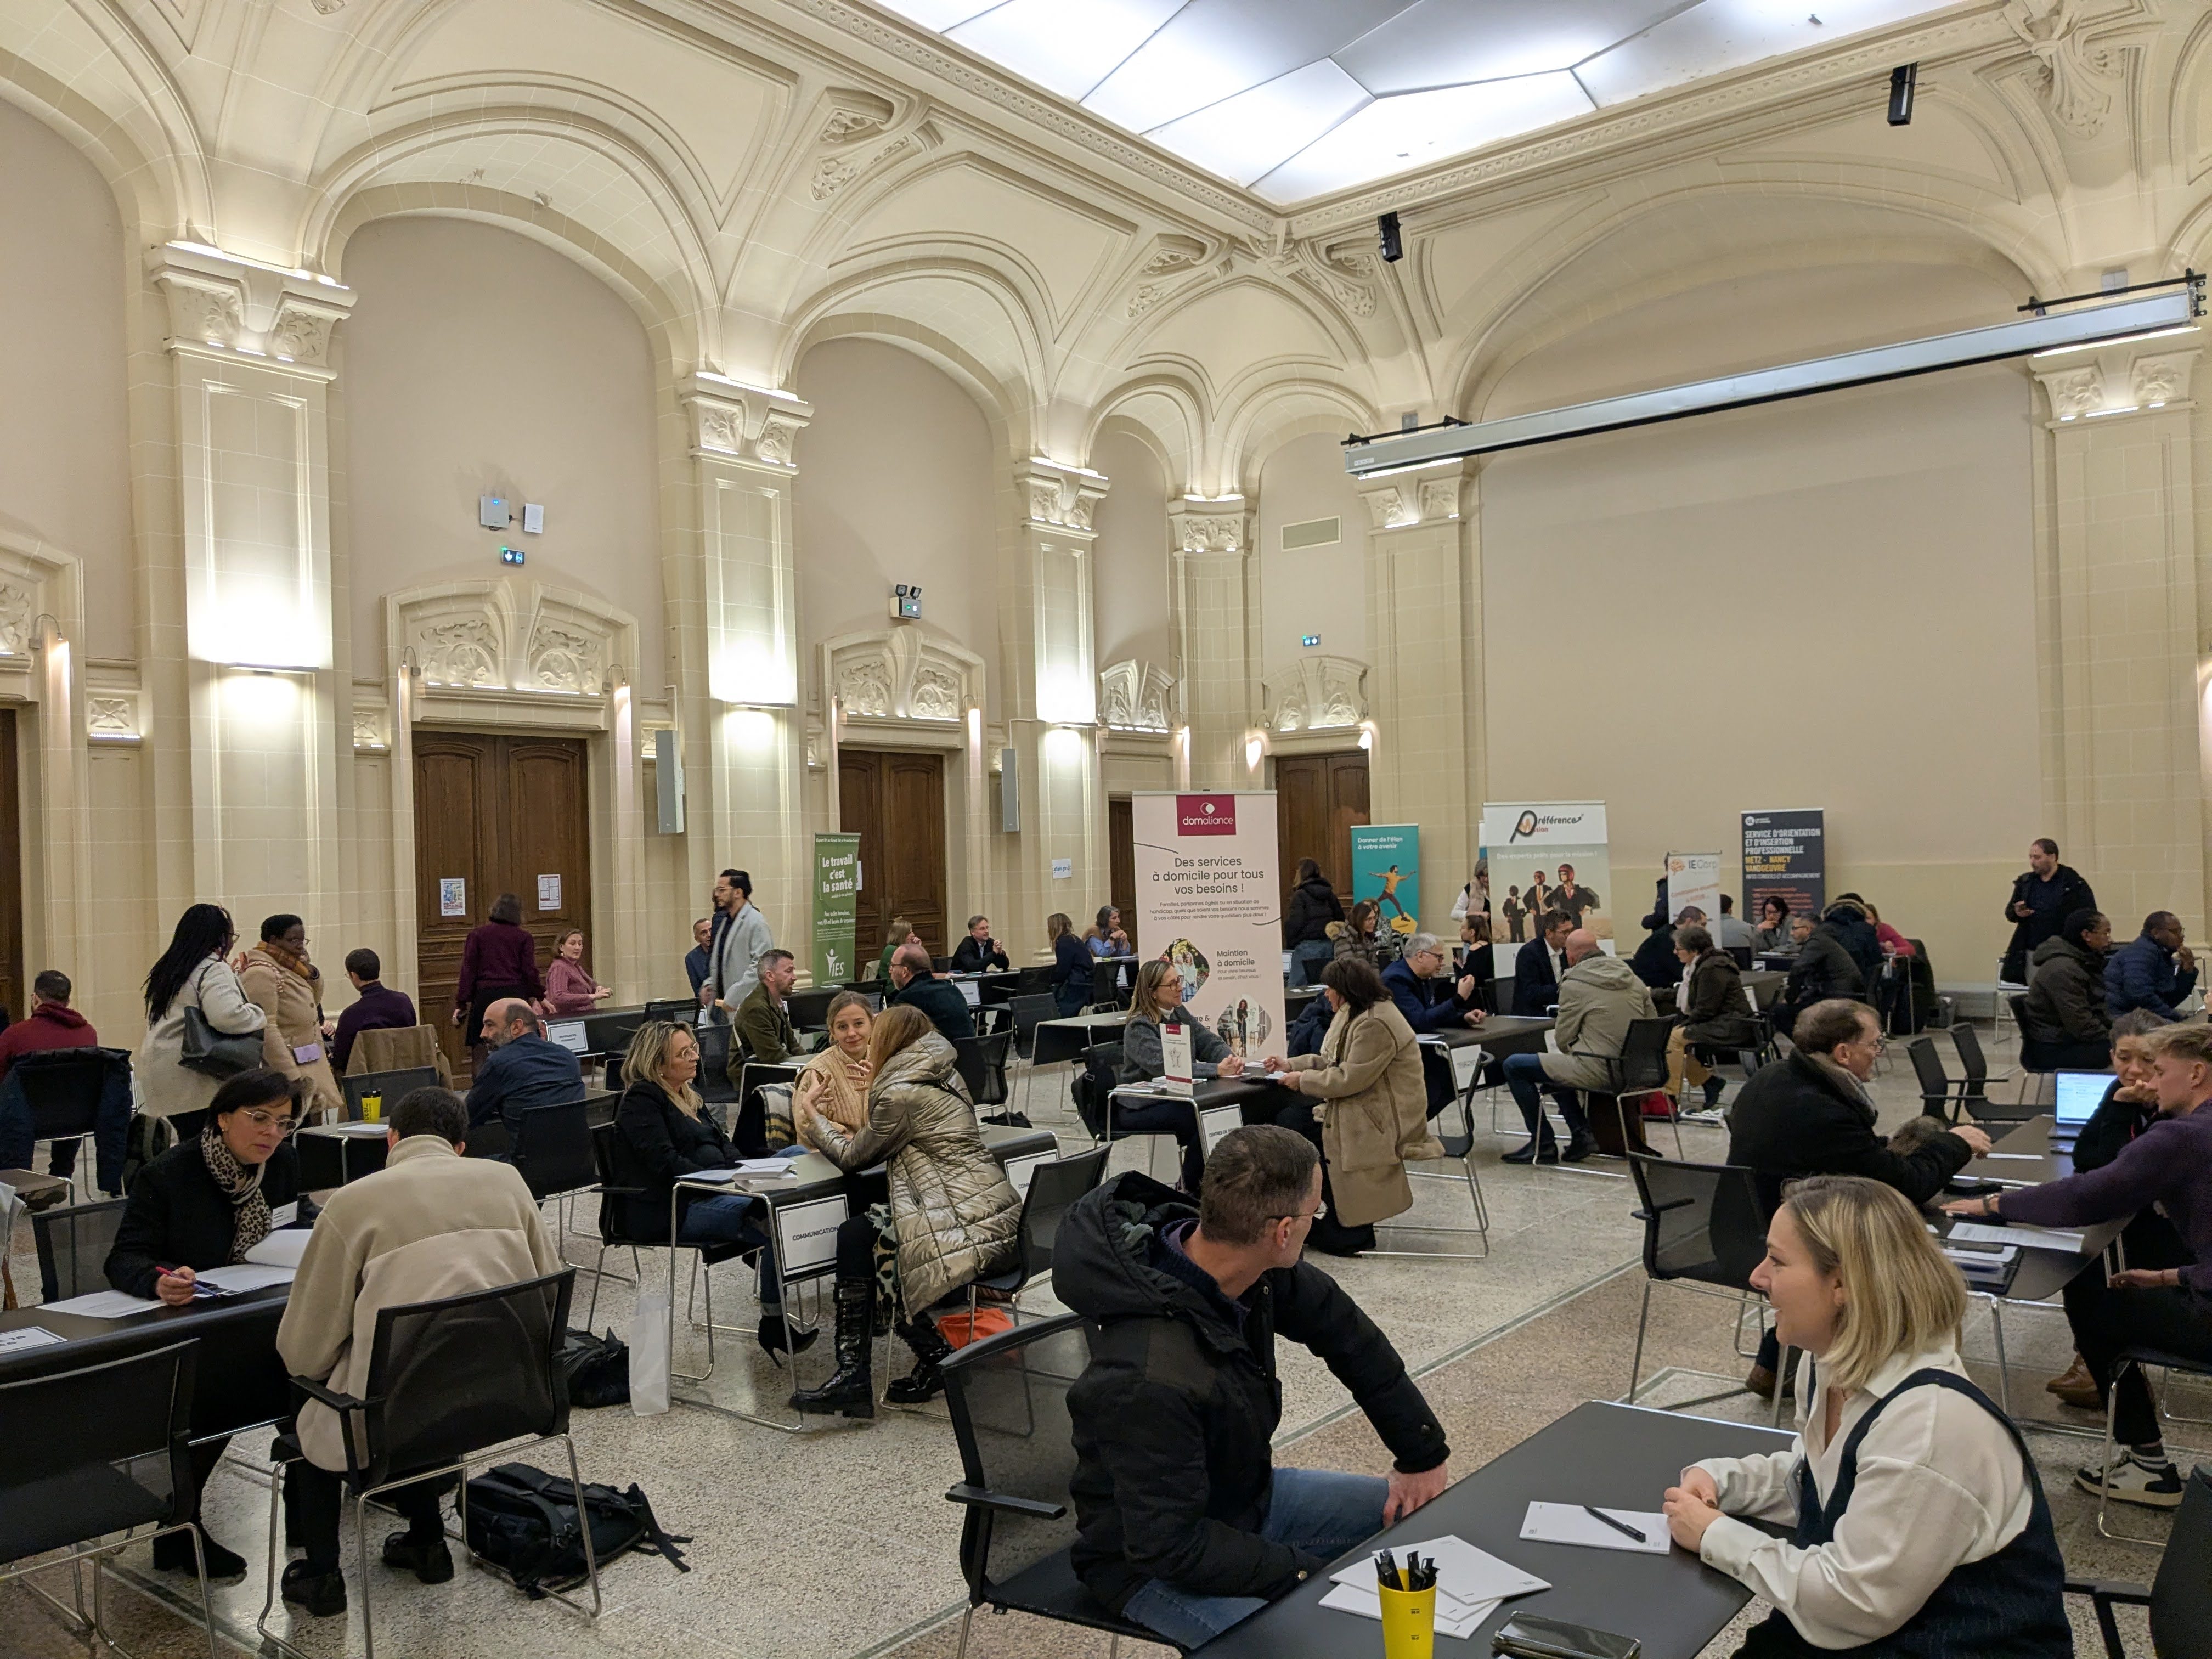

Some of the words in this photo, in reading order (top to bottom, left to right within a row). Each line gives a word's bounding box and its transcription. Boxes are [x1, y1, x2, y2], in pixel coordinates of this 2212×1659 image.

[1183, 816, 1233, 825] domaliance
[822, 857, 830, 867] Le
[831, 854, 853, 867] travail
[1175, 857, 1194, 867] Des
[1197, 856, 1242, 866] services
[830, 869, 845, 880] c'est
[1152, 871, 1160, 881] à
[1163, 870, 1210, 881] domicile
[1213, 871, 1238, 883] pour
[1240, 870, 1264, 879] tous
[823, 881, 830, 893] la
[831, 878, 853, 892] santé
[1174, 885, 1193, 894] vos
[1196, 883, 1238, 894] besoins
[1241, 883, 1244, 893] !
[792, 1226, 839, 1241] COMMUNICATION
